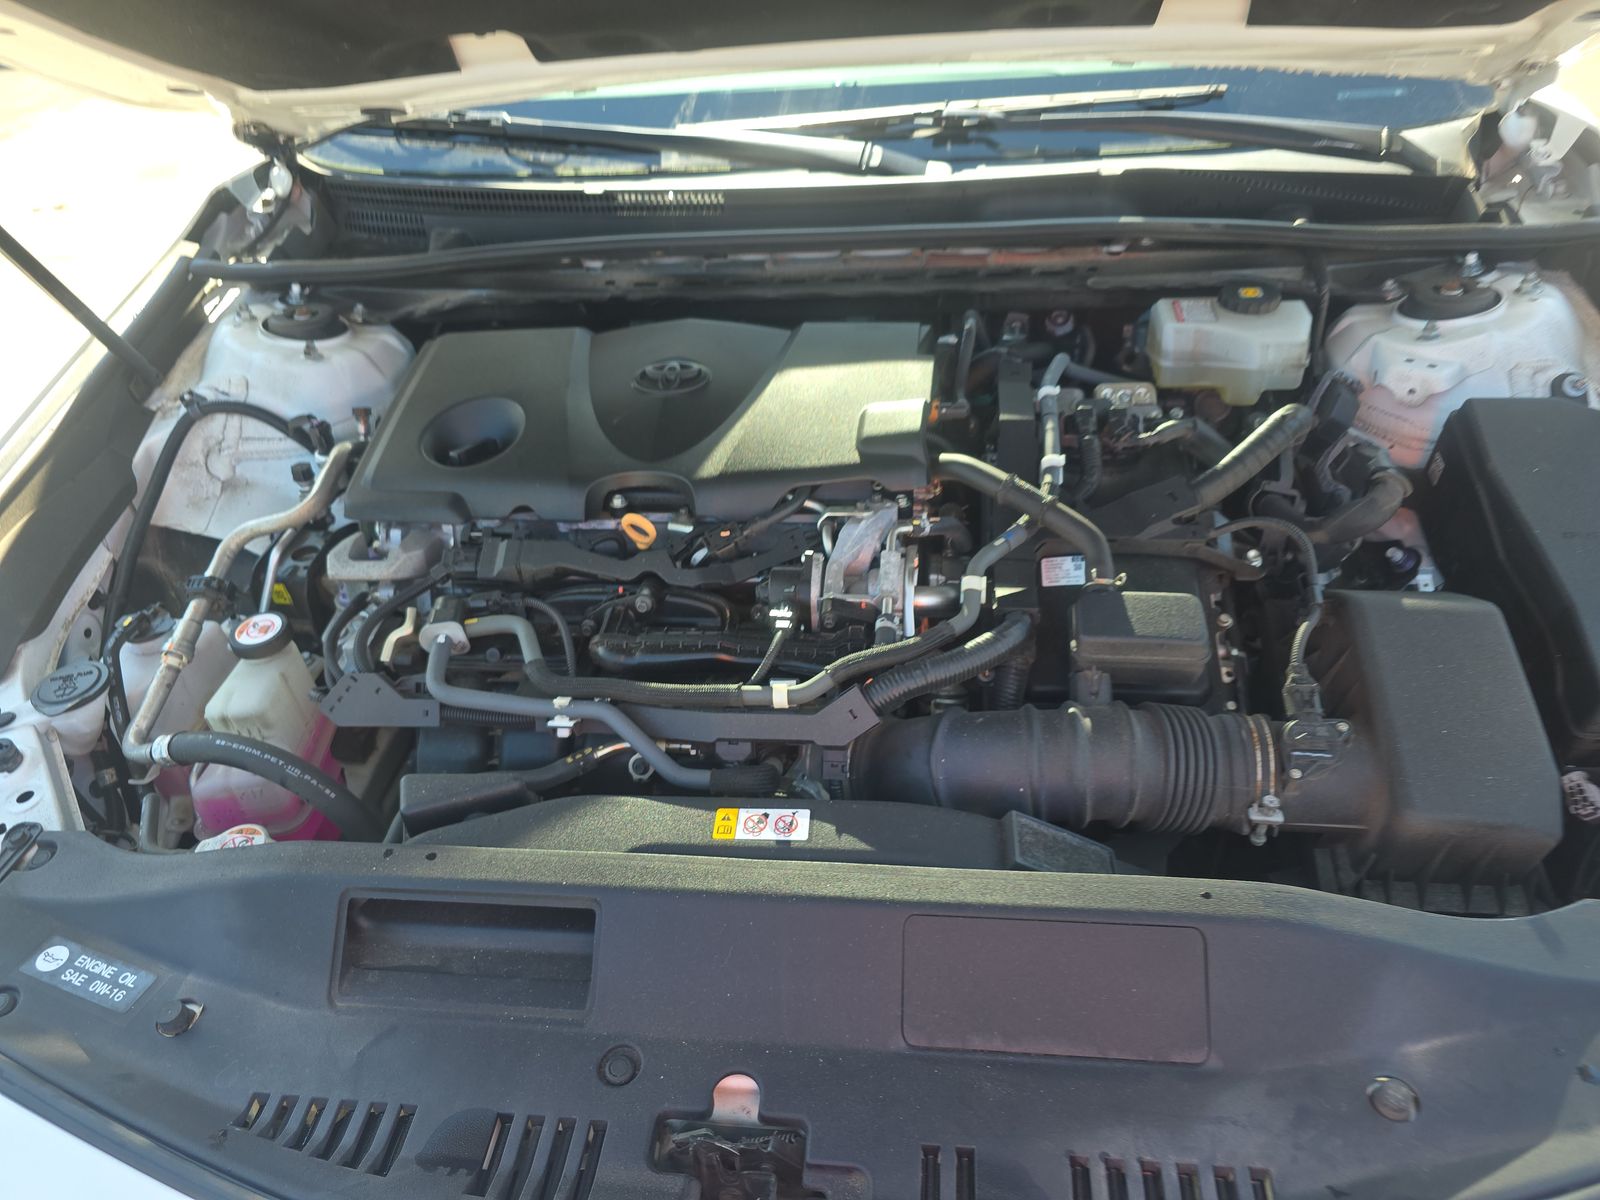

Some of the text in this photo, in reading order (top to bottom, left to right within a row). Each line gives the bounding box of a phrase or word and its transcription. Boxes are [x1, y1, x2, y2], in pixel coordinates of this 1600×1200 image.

[61, 968, 126, 1001] SAE 0W-16
[75, 956, 137, 988] ENGINE OIL
